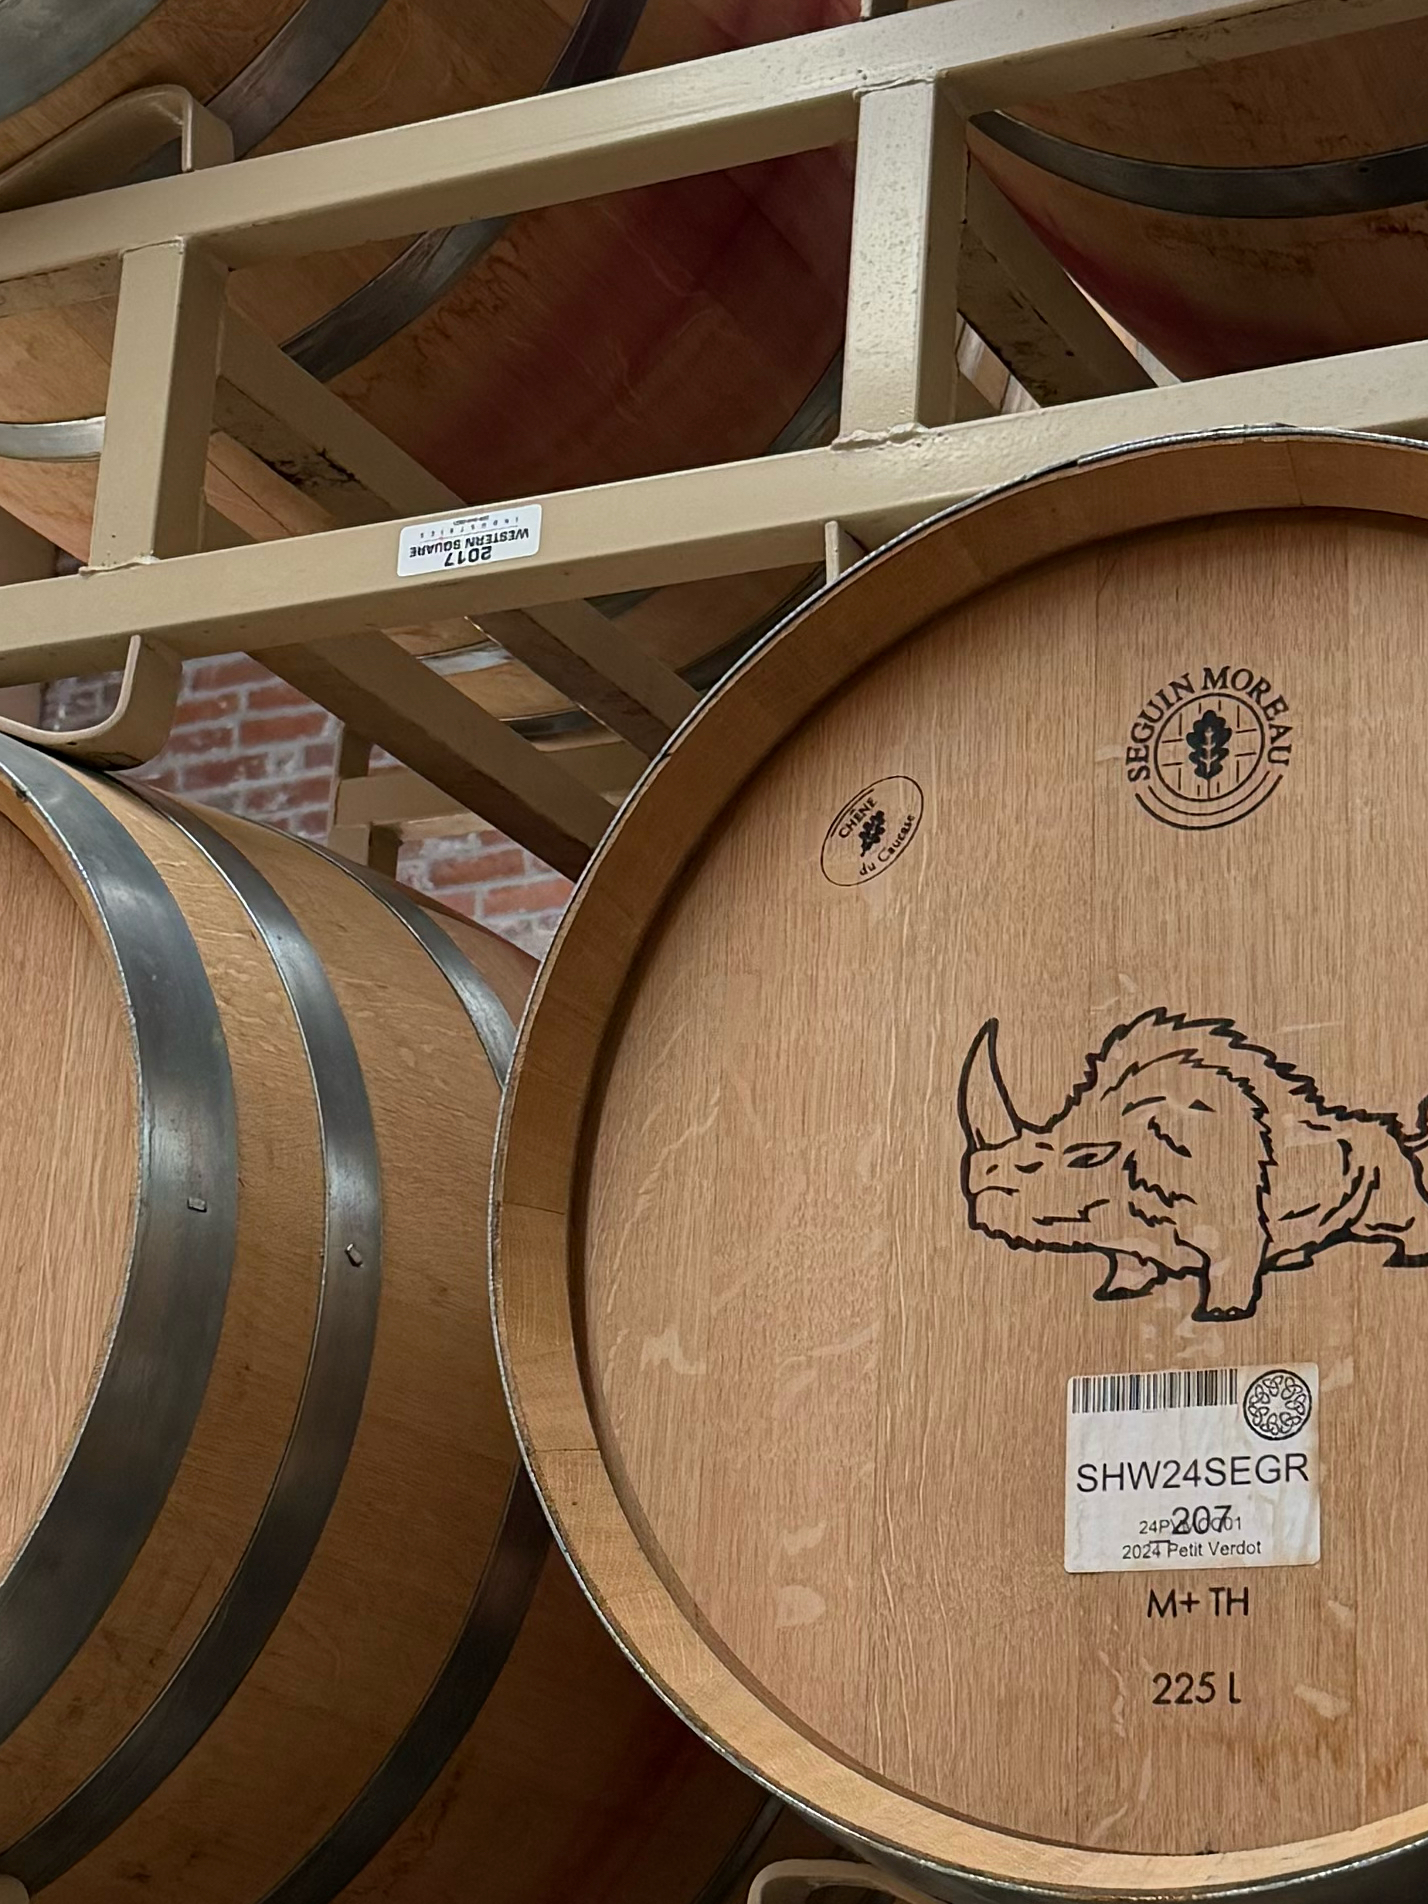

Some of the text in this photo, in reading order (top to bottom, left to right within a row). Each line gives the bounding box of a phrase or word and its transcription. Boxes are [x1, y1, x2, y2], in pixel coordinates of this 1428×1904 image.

[408, 527, 530, 558] WESTERN SQUARE
[443, 545, 493, 568] 2017
[1125, 665, 1294, 783] SEGUIN MOREAU
[859, 815, 915, 876] du Caucase
[1076, 1452, 1310, 1493] SHW24SEGR
[1122, 1540, 1262, 1560] 2024 Petit Verdot
[1208, 1586, 1249, 1617] TH
[1152, 1671, 1216, 1705] 225
